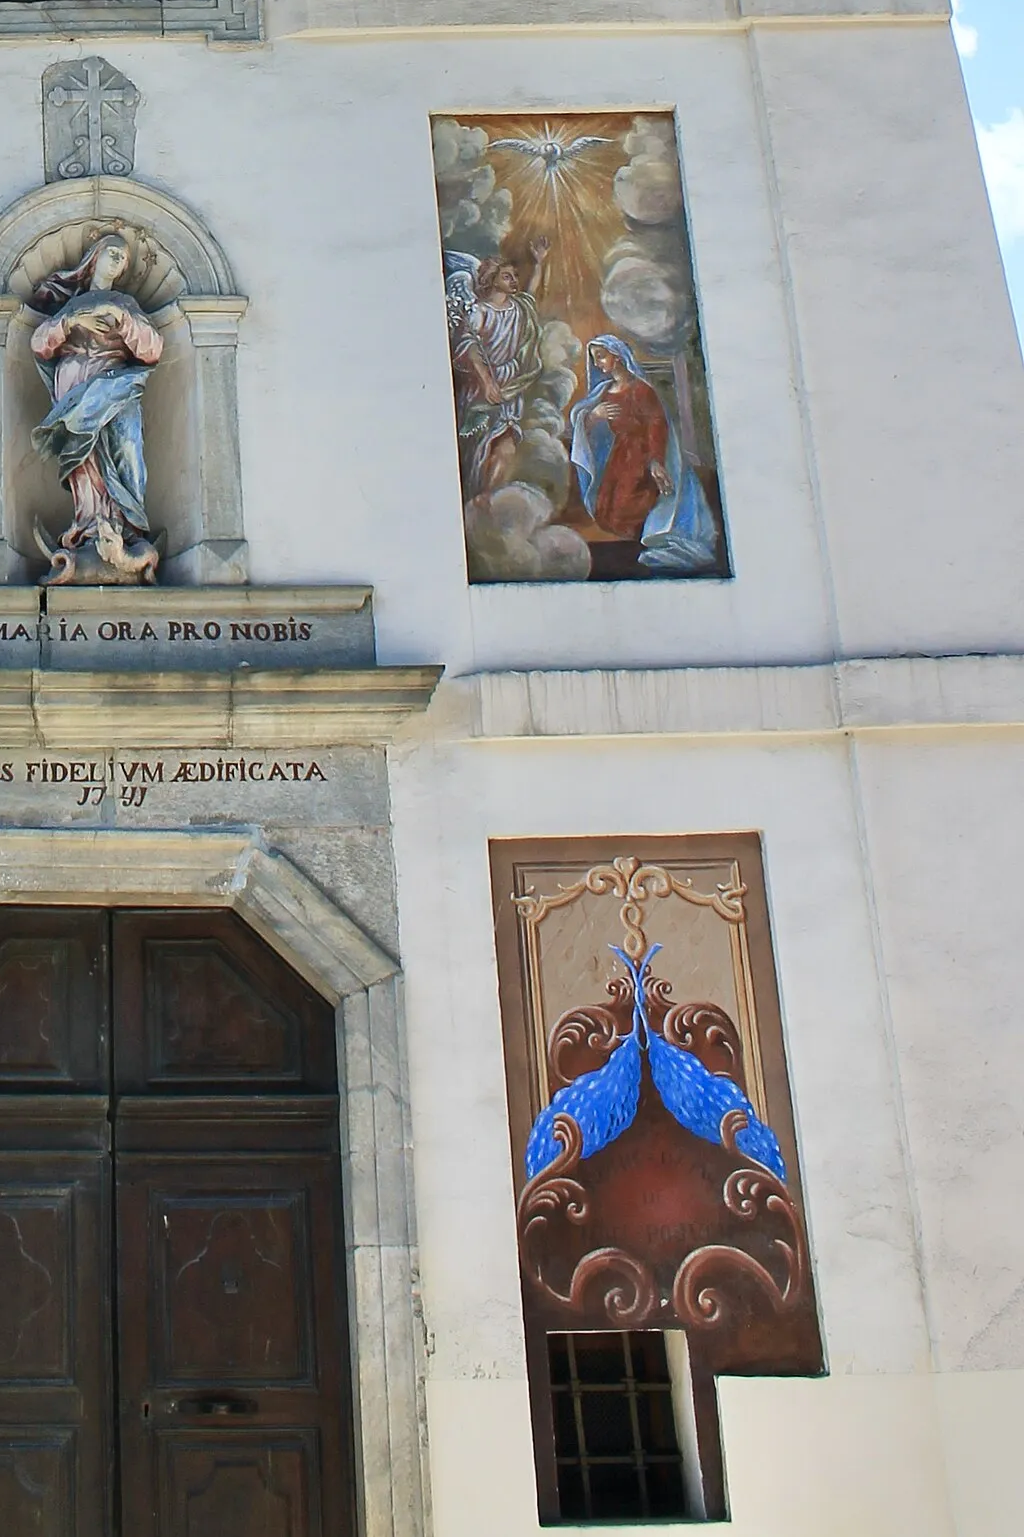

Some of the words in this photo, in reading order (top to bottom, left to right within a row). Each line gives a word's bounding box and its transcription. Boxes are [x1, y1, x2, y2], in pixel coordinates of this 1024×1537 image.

[97, 621, 158, 642] ORA
[167, 621, 222, 642] PRO
[229, 616, 313, 642] NOBIS
